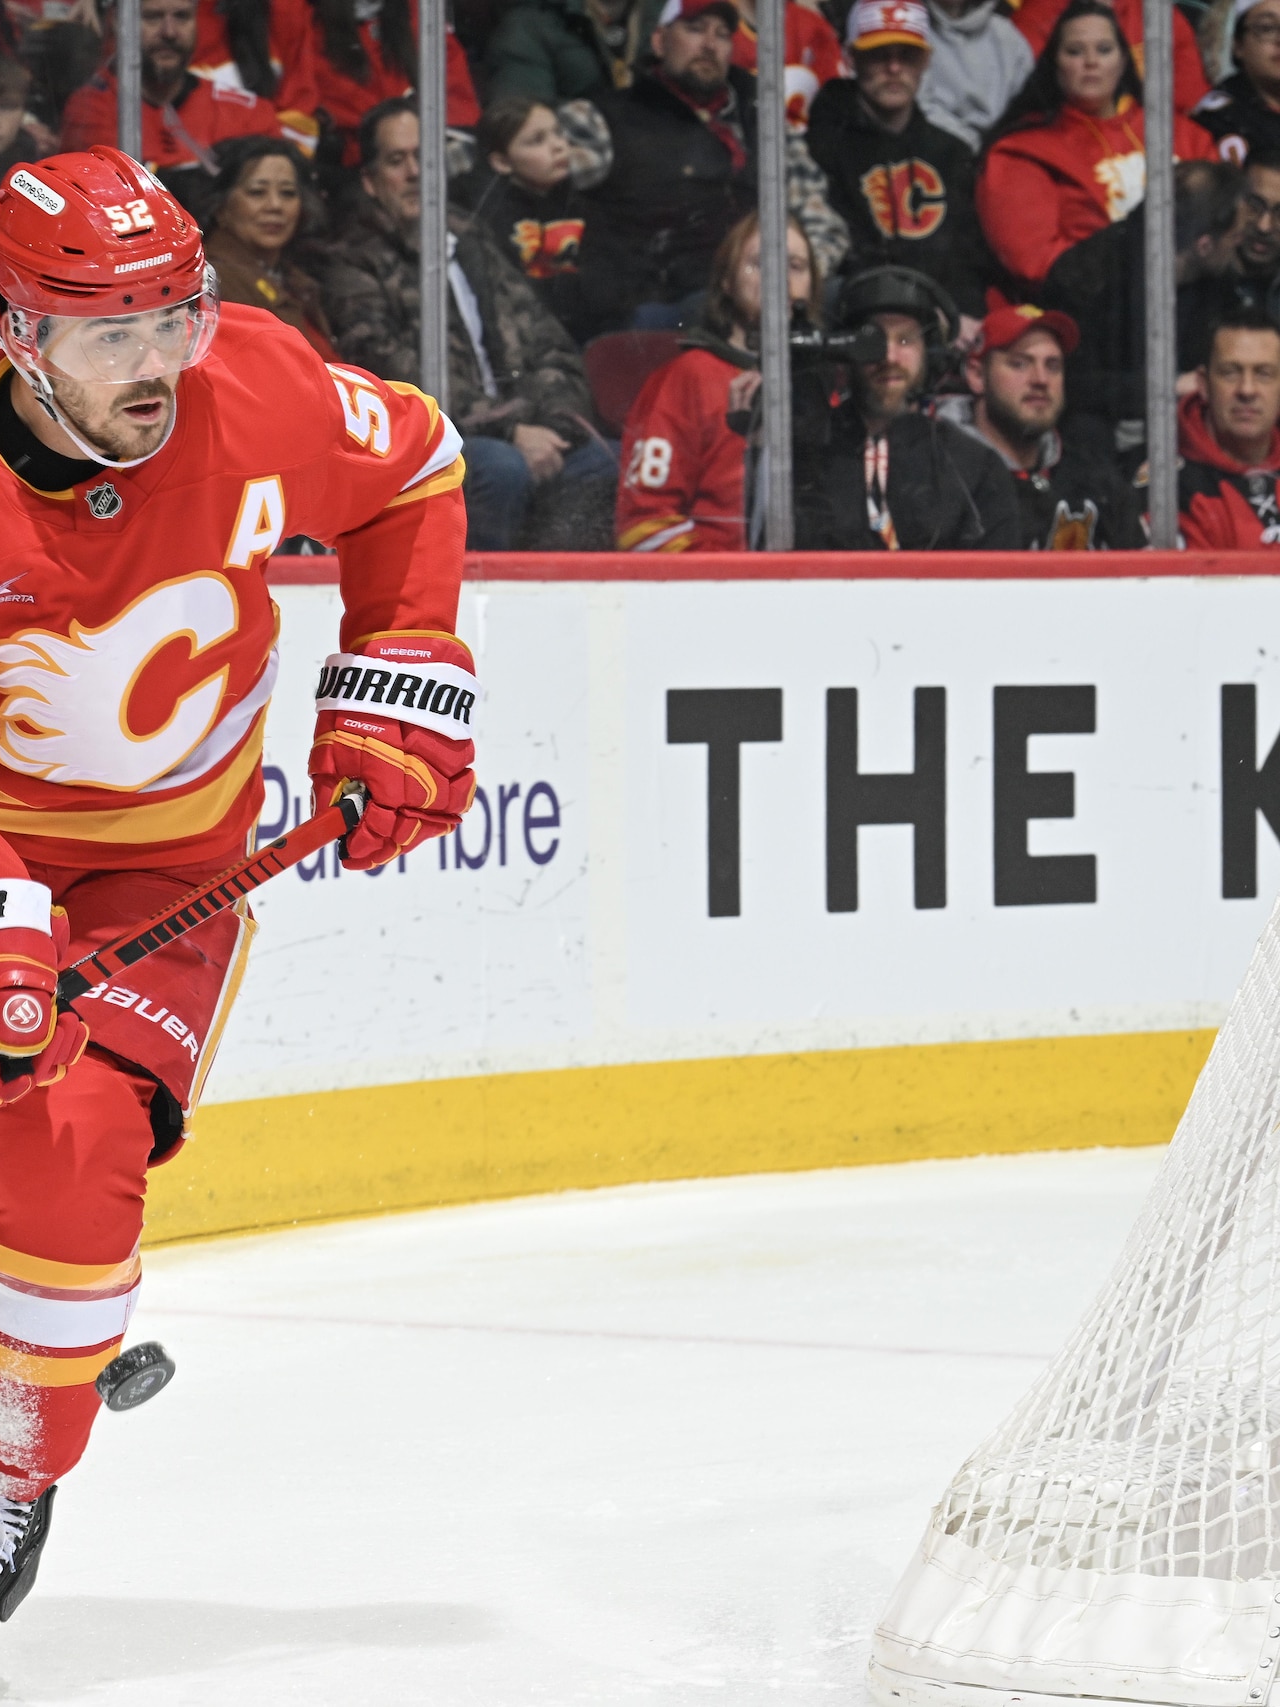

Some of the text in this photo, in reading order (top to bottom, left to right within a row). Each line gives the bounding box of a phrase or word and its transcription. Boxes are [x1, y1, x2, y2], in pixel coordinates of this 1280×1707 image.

[13, 173, 59, 212] GameSense
[104, 200, 155, 235] 52
[114, 252, 174, 275] WARRIOR
[223, 474, 287, 570] A
[380, 647, 432, 659] WEEGAR
[343, 719, 386, 735] COVERT
[666, 683, 1097, 917] THE
